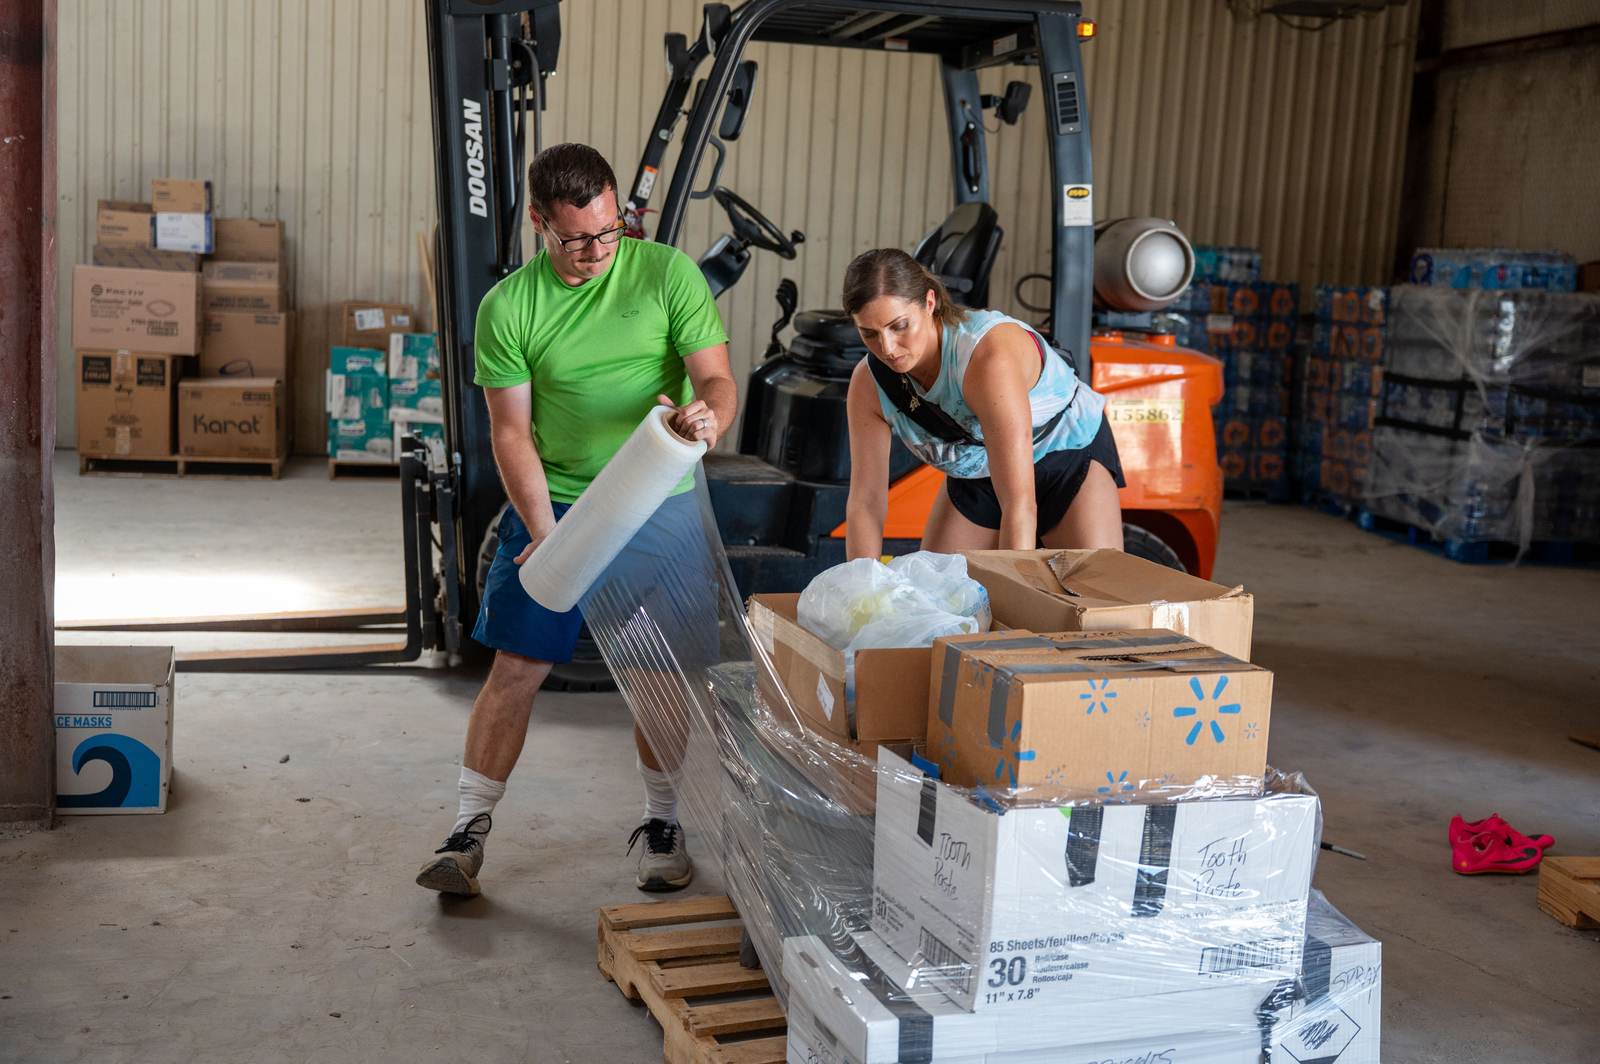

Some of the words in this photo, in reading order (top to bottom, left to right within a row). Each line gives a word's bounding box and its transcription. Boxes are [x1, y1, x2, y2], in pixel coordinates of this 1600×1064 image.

[463, 98, 488, 218] DOOSAN
[193, 413, 261, 434] Karat
[57, 716, 70, 727] CE
[73, 716, 112, 727] MASKS
[989, 941, 1004, 953] 85
[987, 956, 1027, 988] 30
[1032, 973, 1073, 984] Rollos/caja
[1007, 992, 1014, 1001] x
